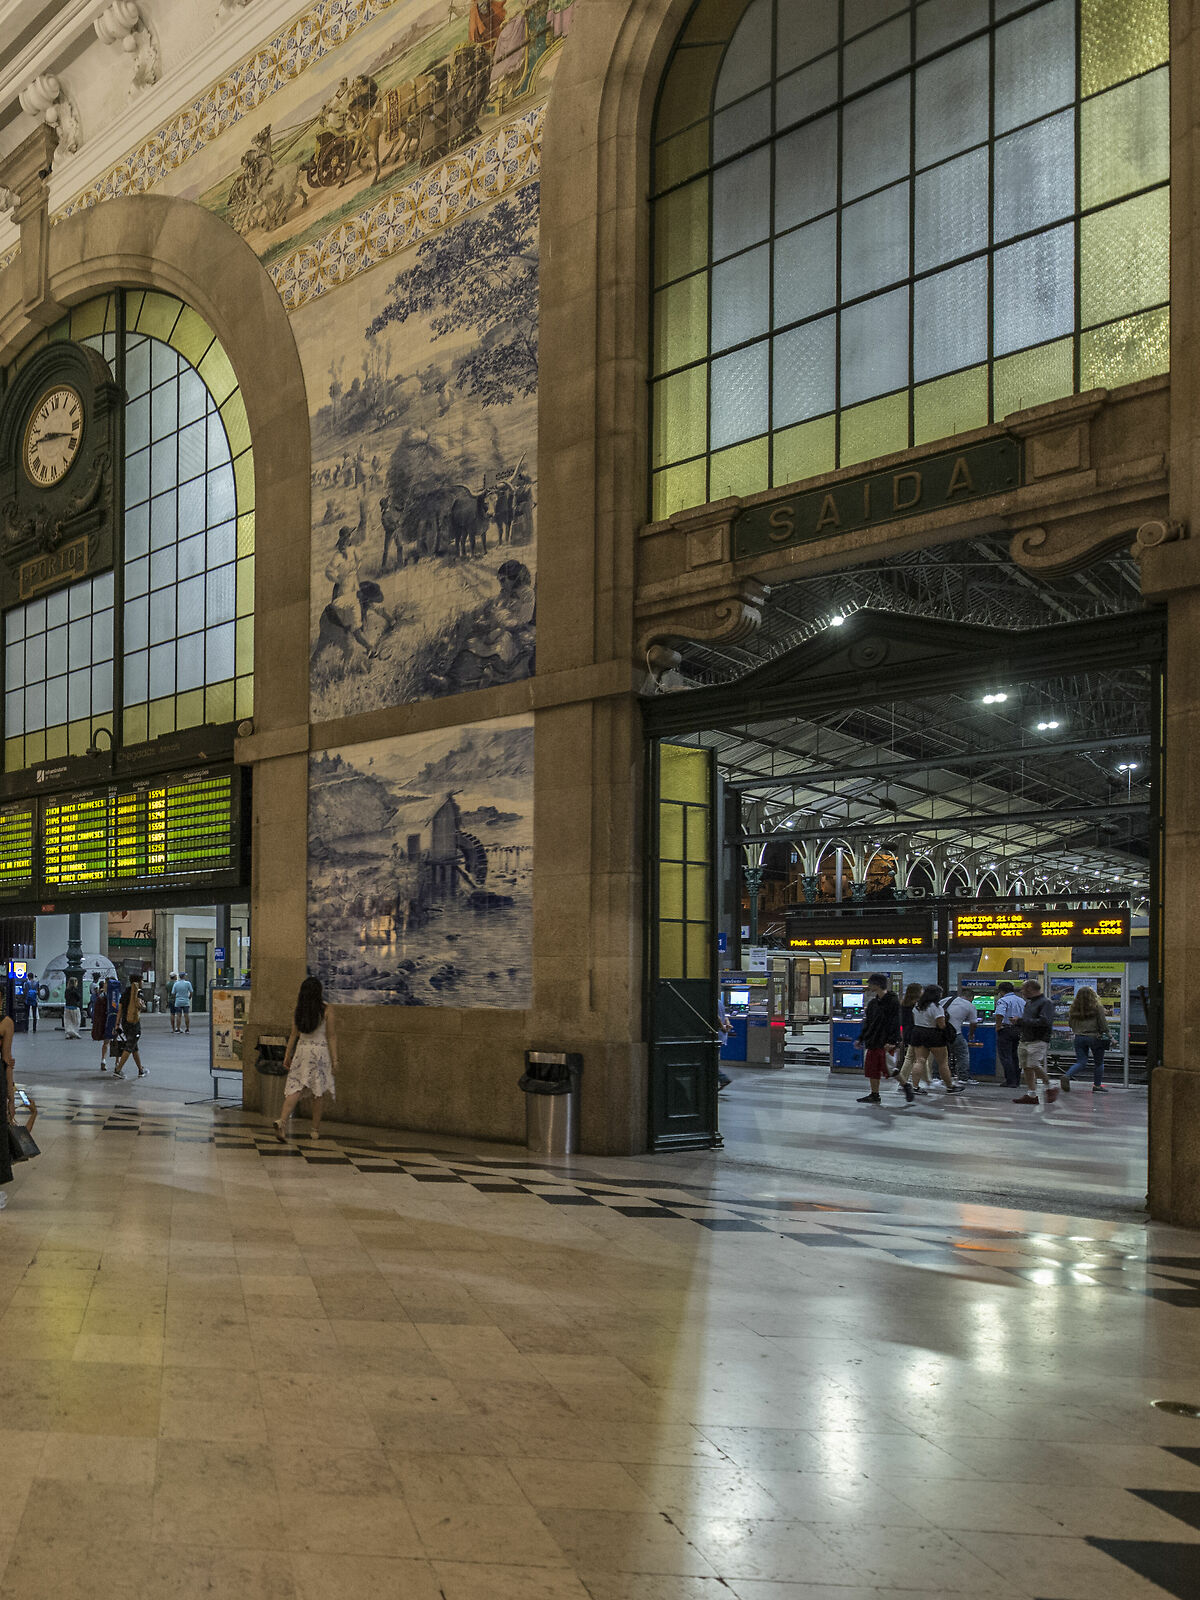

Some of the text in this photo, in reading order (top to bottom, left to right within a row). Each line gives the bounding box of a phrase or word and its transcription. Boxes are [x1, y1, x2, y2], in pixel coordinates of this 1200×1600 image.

[768, 456, 978, 543] SAIDA
[28, 546, 77, 582] PORTO
[149, 866, 165, 874] 15552
[957, 915, 993, 923] PARTIDA
[1040, 920, 1074, 929] SUBURB
[1082, 927, 1123, 935] OLEIROS
